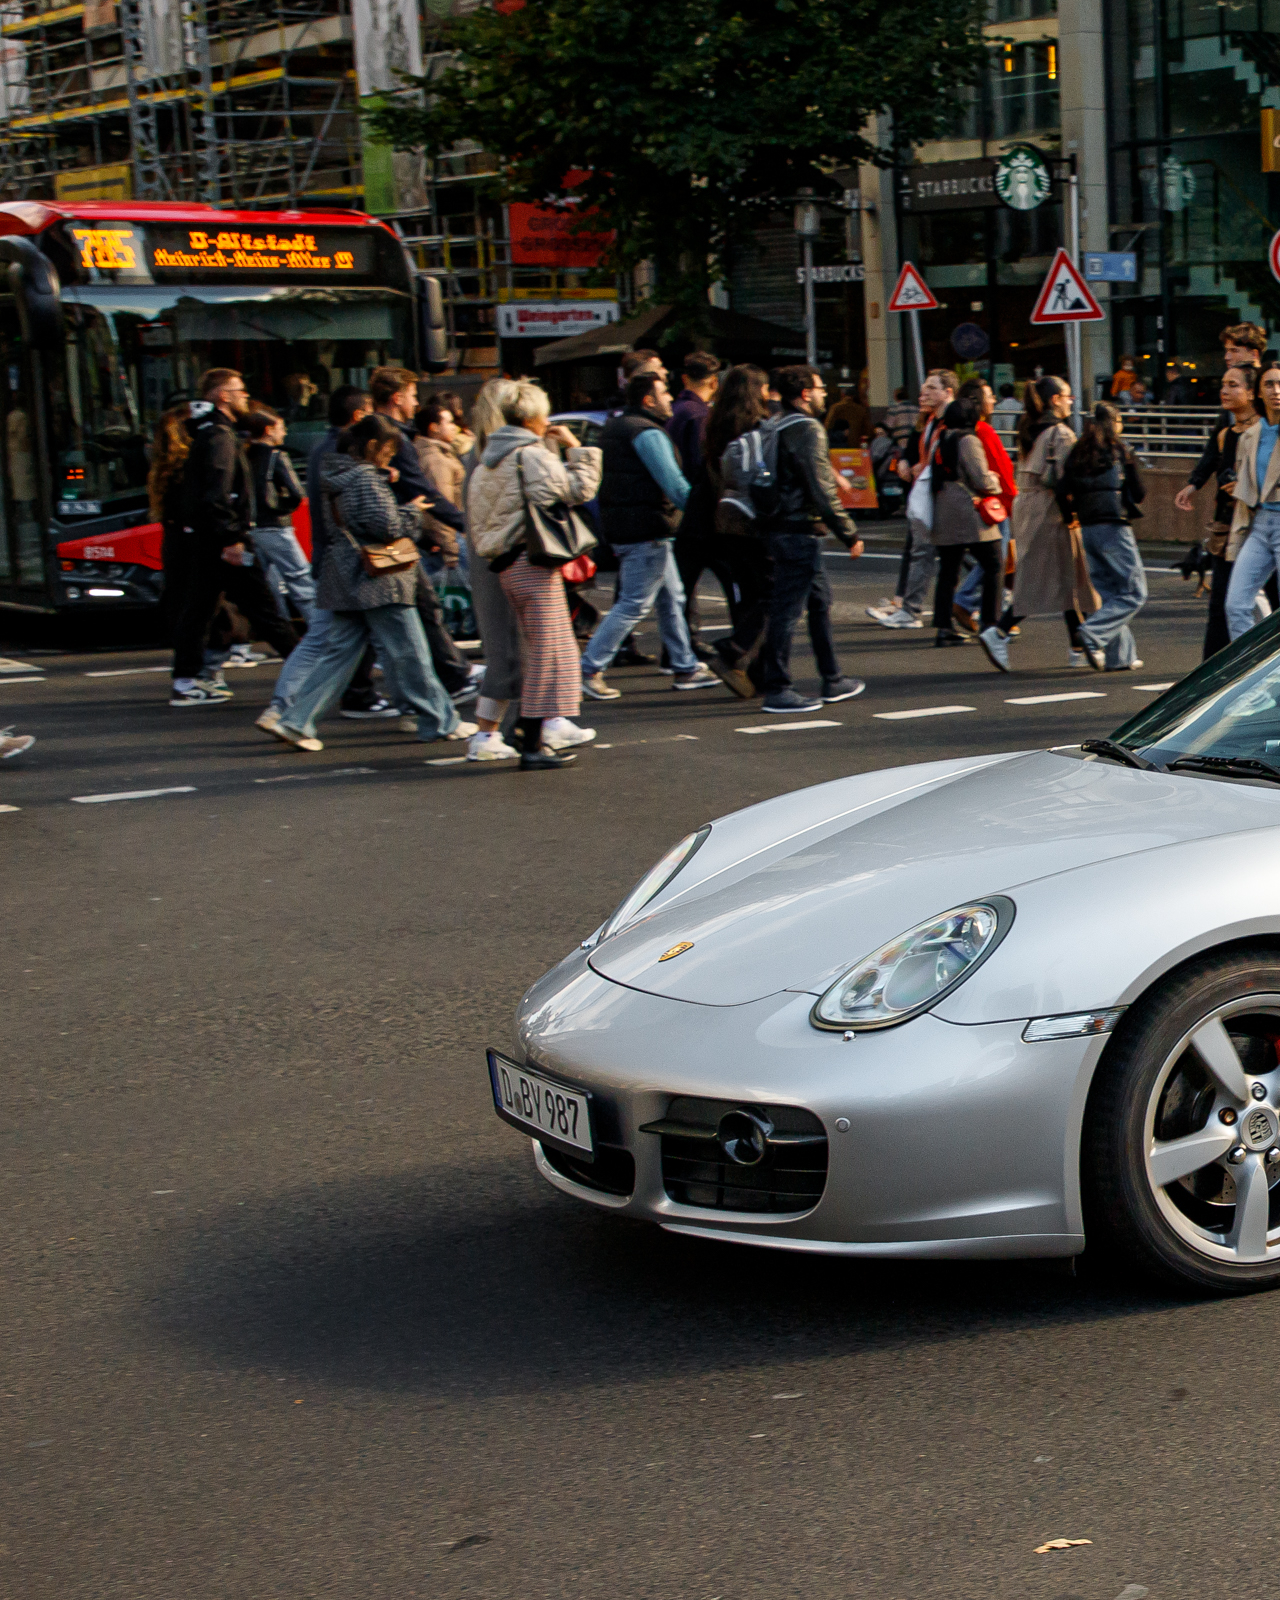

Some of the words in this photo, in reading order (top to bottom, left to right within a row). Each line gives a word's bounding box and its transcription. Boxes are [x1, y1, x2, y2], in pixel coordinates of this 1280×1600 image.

[917, 175, 994, 198] STARBUCKS
[500, 1066, 514, 1109] D
[520, 1075, 542, 1124] BY
[545, 1088, 579, 1140] 987
